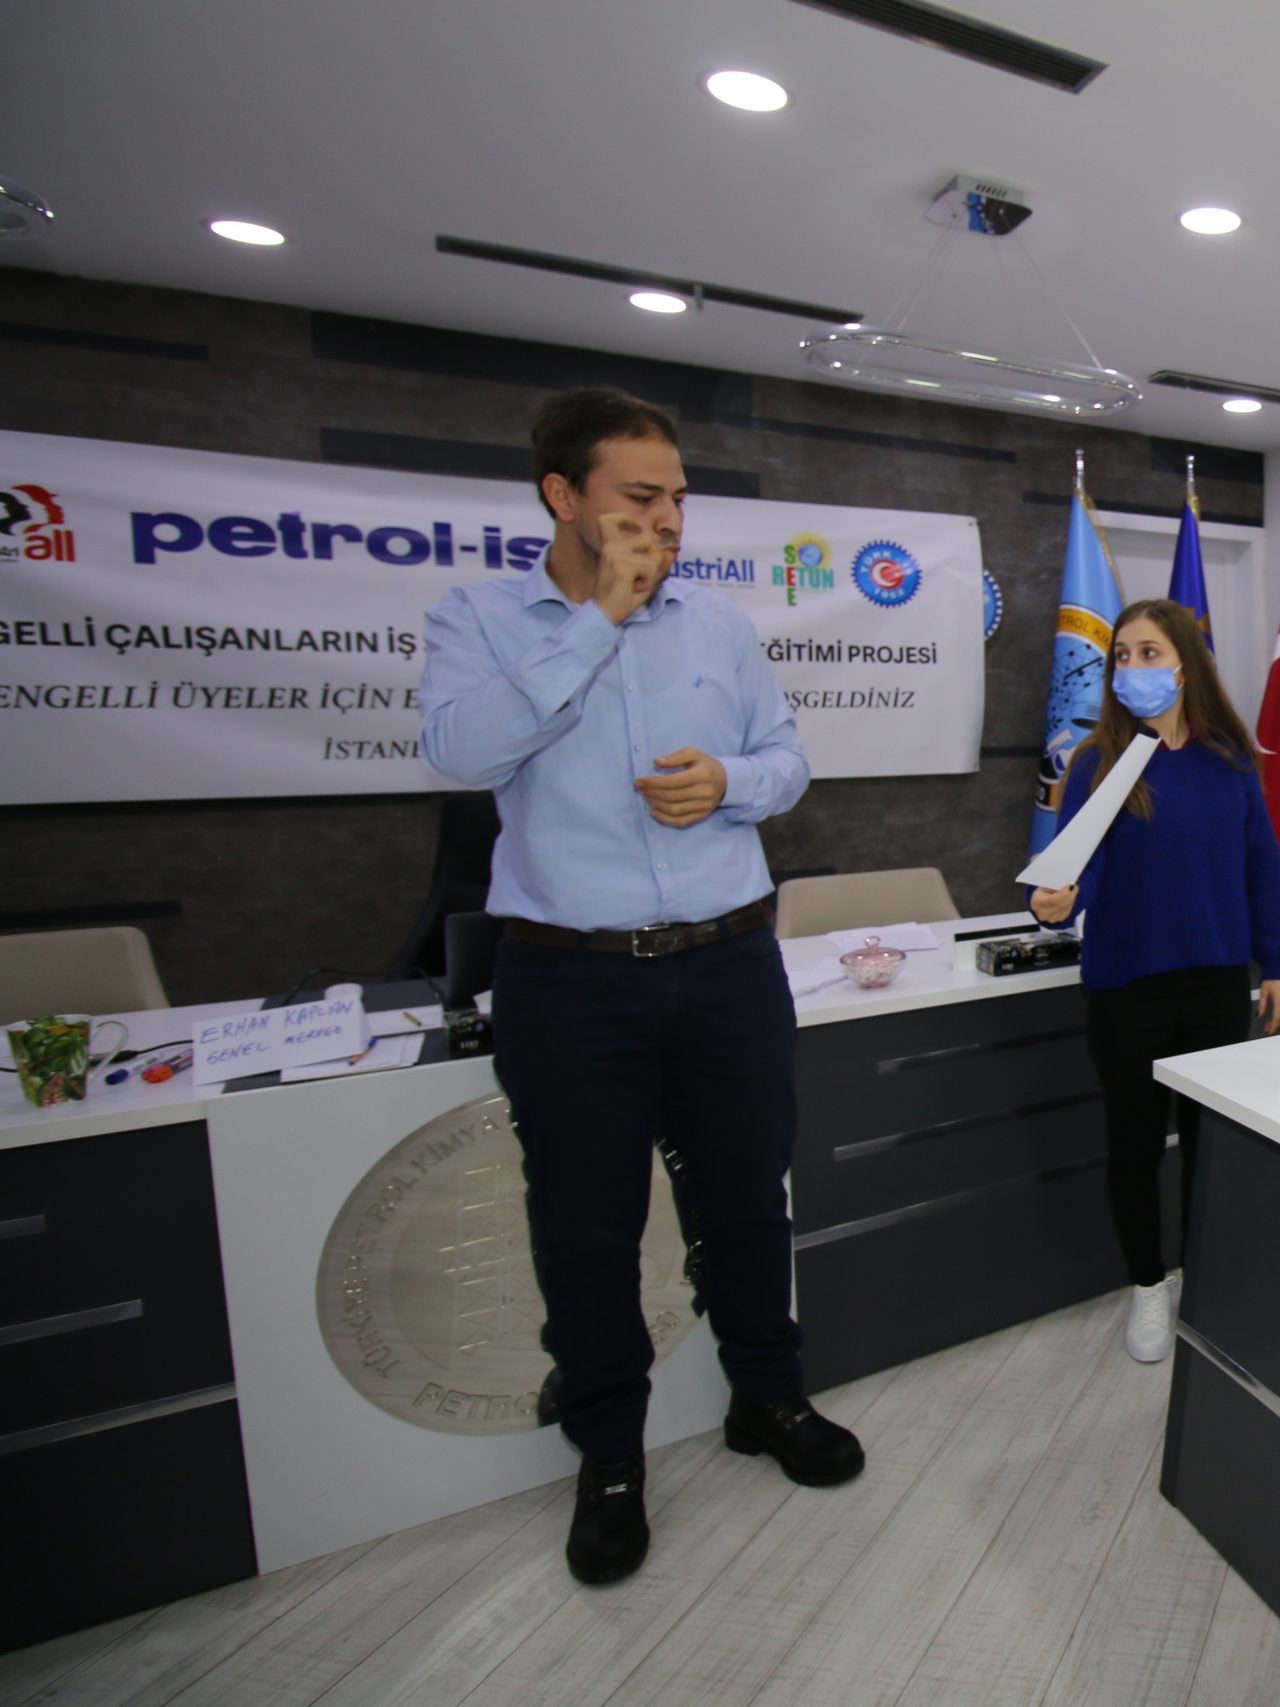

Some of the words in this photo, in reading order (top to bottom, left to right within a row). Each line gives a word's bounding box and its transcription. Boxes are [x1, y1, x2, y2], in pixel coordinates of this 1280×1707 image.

[23, 529, 76, 562] all
[105, 622, 379, 657] ÇALIŞANLARIN
[387, 625, 417, 661] İŞ
[760, 638, 843, 663] ĞİTİMİ
[847, 642, 938, 665] PROJESİ
[171, 681, 309, 710] ÜYELER
[319, 682, 394, 716] İÇİN
[784, 686, 916, 713] ŞGELDİNİZ
[200, 1014, 271, 1045] ERHAN
[283, 1000, 354, 1029] KAPLAN
[205, 1042, 273, 1065] GENEL
